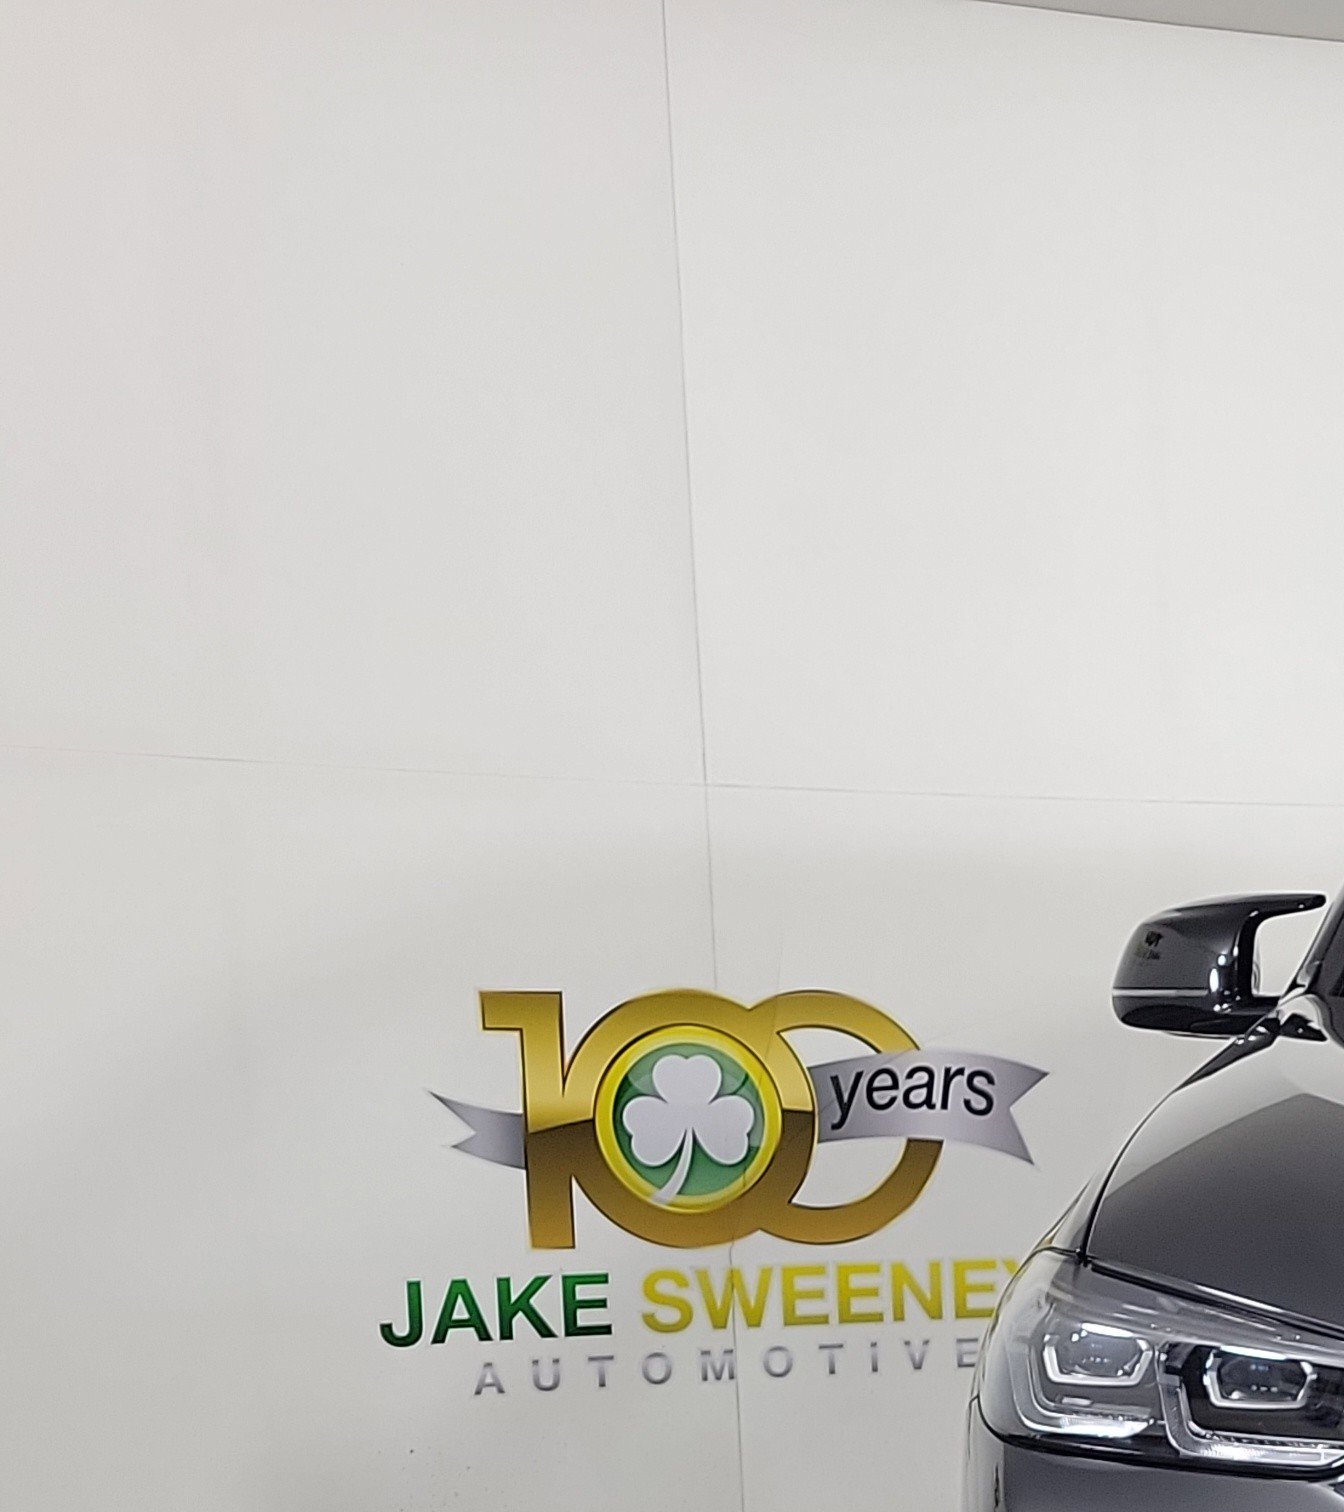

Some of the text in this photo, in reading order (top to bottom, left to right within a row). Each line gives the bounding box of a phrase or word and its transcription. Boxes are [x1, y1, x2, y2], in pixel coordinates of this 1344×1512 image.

[479, 988, 997, 1250] 100 years
[379, 1273, 613, 1348] JAKE
[473, 1338, 978, 1397] AUTOMOTIVE
